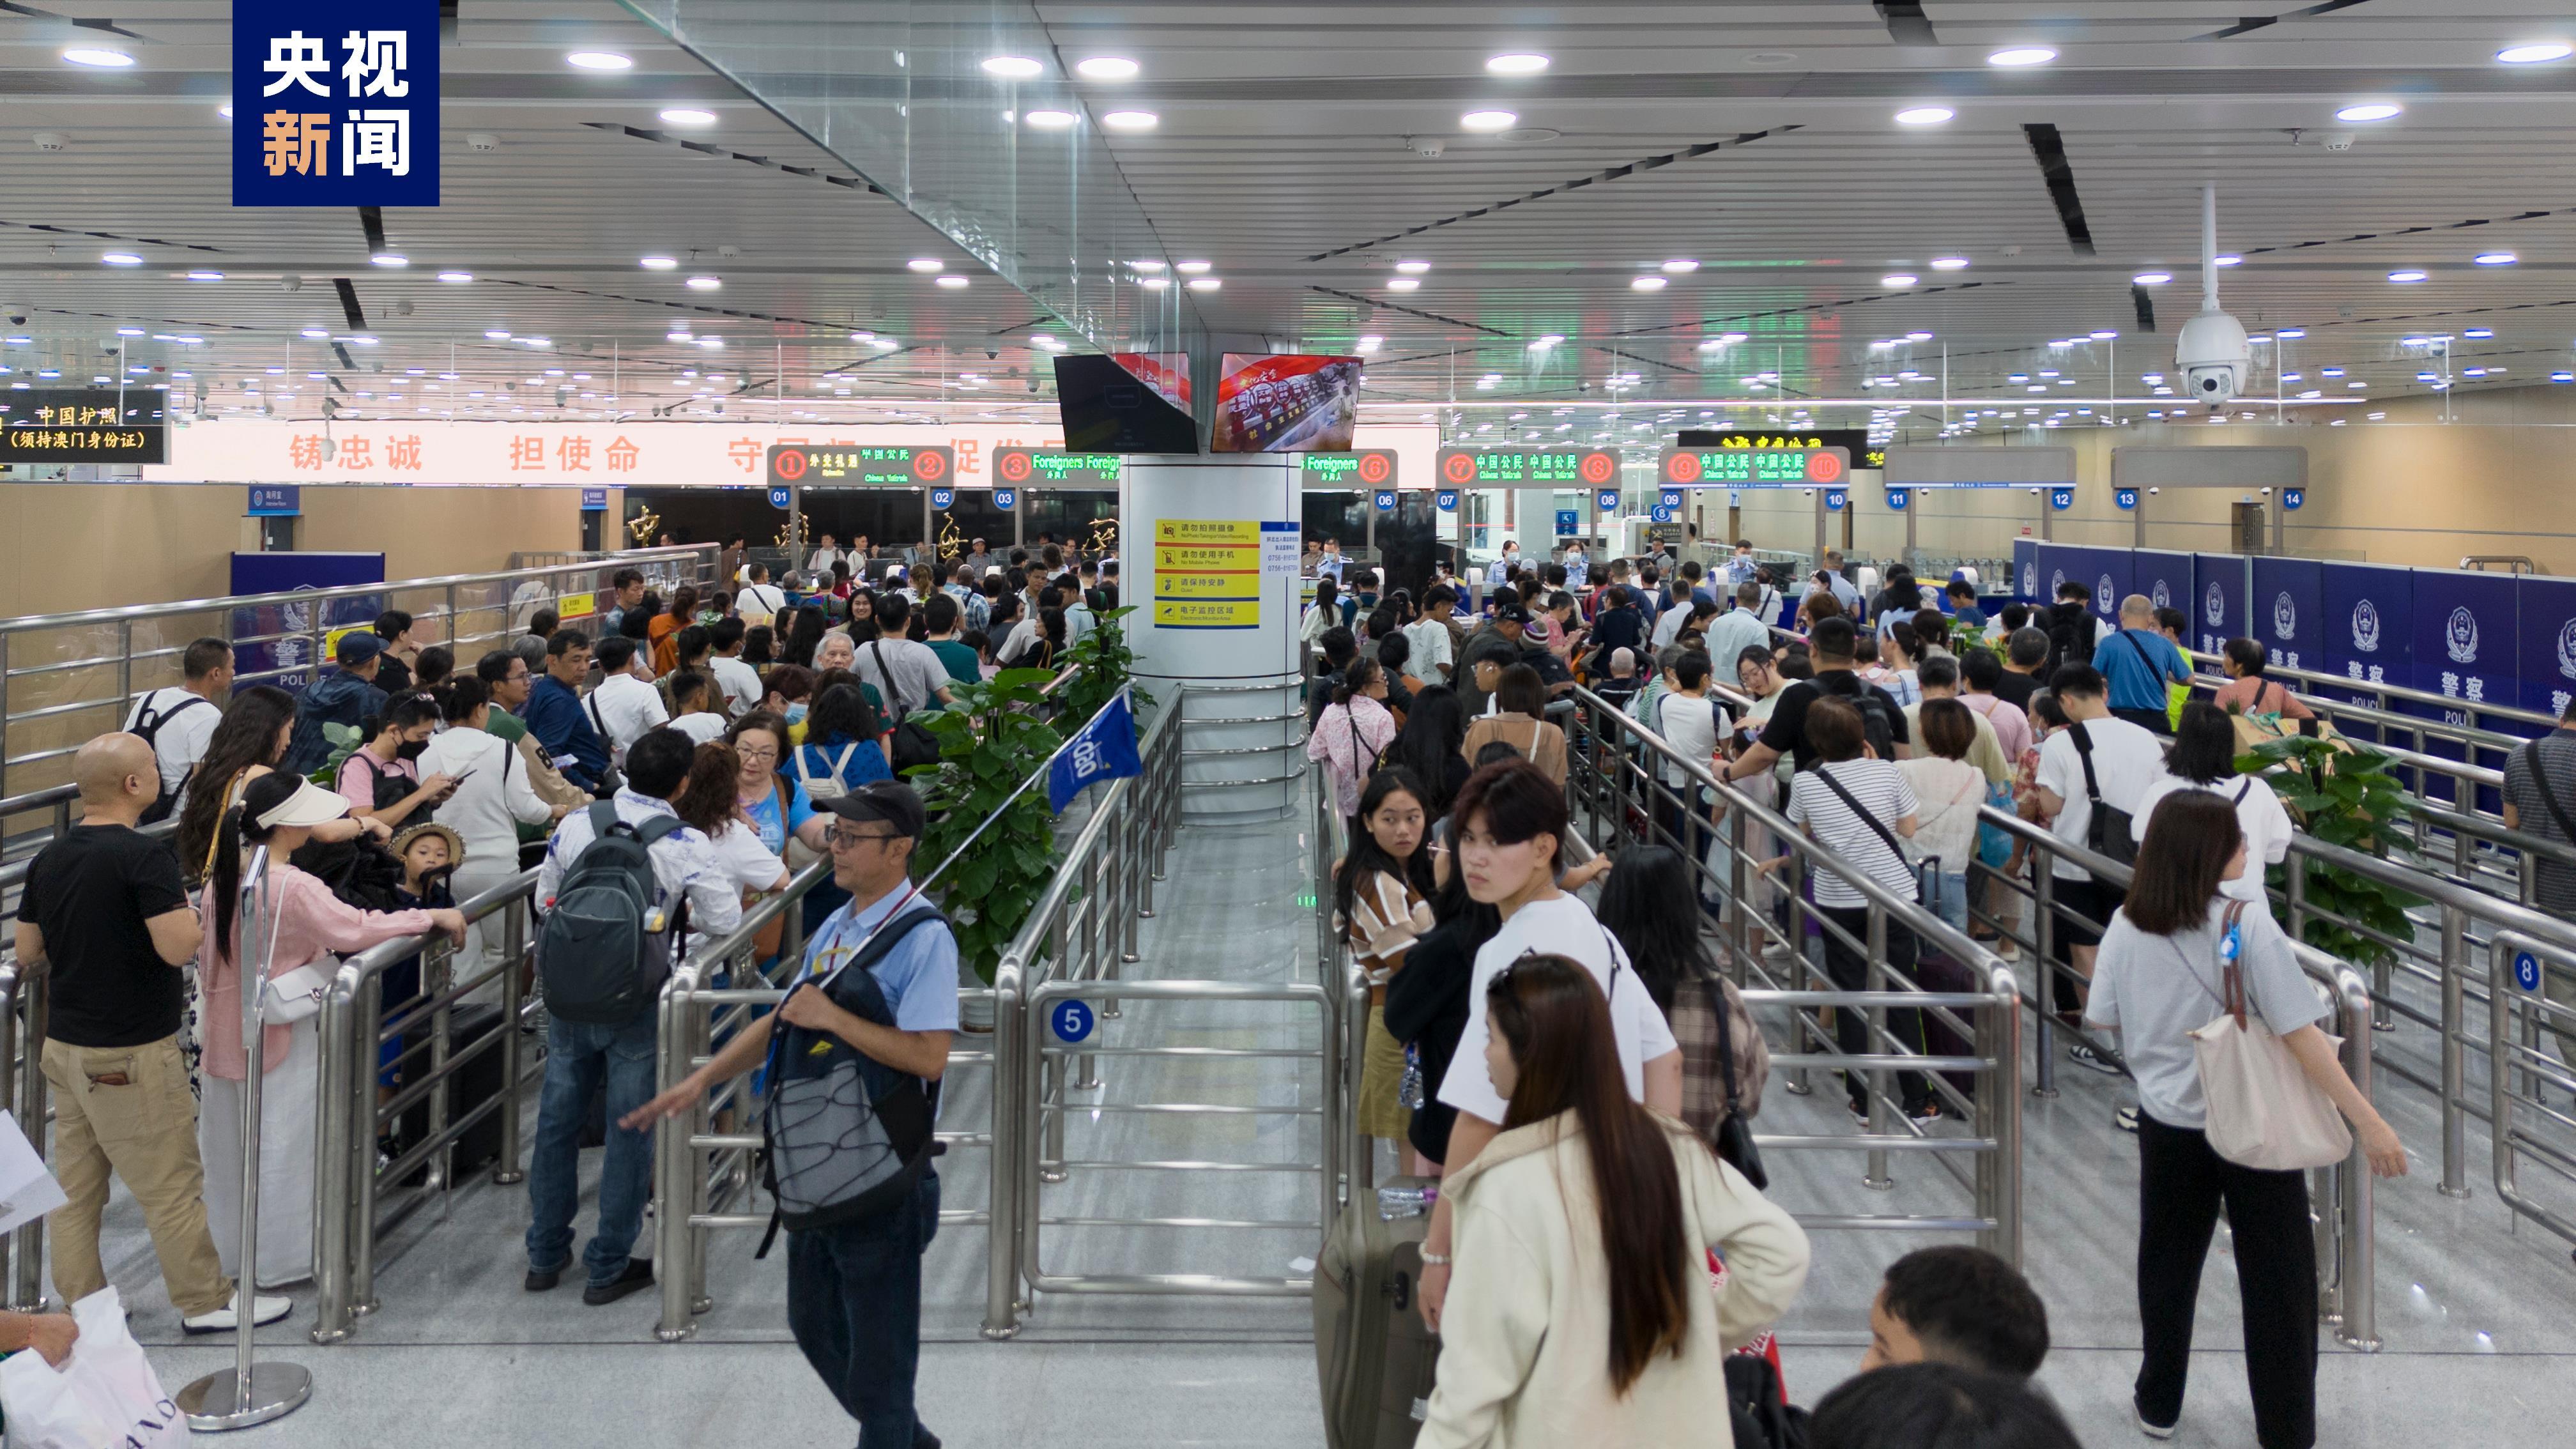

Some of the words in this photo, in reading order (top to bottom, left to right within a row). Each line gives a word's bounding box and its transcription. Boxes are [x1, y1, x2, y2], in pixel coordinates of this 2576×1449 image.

[39, 406, 117, 427] 中国护照
[289, 434, 422, 470] 铸忠诚
[509, 435, 641, 472] 担使命
[1032, 454, 1084, 471] Foreigners
[1086, 454, 1120, 471] Foreign
[1307, 456, 1358, 472] Foreigners
[1476, 454, 1523, 470] 中国公民
[1529, 454, 1577, 470] 中国公民
[1701, 453, 1749, 468] 中国公民
[1756, 453, 1804, 468] 中国公民
[774, 493, 786, 502] 01
[935, 493, 949, 503] 02
[998, 493, 1012, 503] 03
[1379, 495, 1392, 505] 06
[1440, 495, 1454, 505] 07
[1601, 495, 1615, 505] 08
[1664, 495, 1679, 505] 09
[1829, 494, 1843, 505] 10
[1892, 494, 1904, 504] 11
[2055, 494, 2069, 505] 12
[2120, 493, 2135, 505] 13
[2285, 493, 2300, 505] 14
[1659, 509, 1666, 518] 8
[1181, 524, 1235, 532] 请勿拍照摄像
[1181, 551, 1234, 559] 请勿使用手机
[1181, 578, 1225, 586] 请保持安静
[2271, 648, 2299, 670] 警察
[2205, 664, 2225, 678] POLICE
[2348, 660, 2384, 684] 警察
[2442, 671, 2484, 702] 警察
[2352, 696, 2379, 709] POLIC
[2445, 710, 2466, 726] POLI
[535, 746, 555, 770] 8
[2520, 958, 2533, 983] 8
[1065, 1008, 1082, 1033] 5
